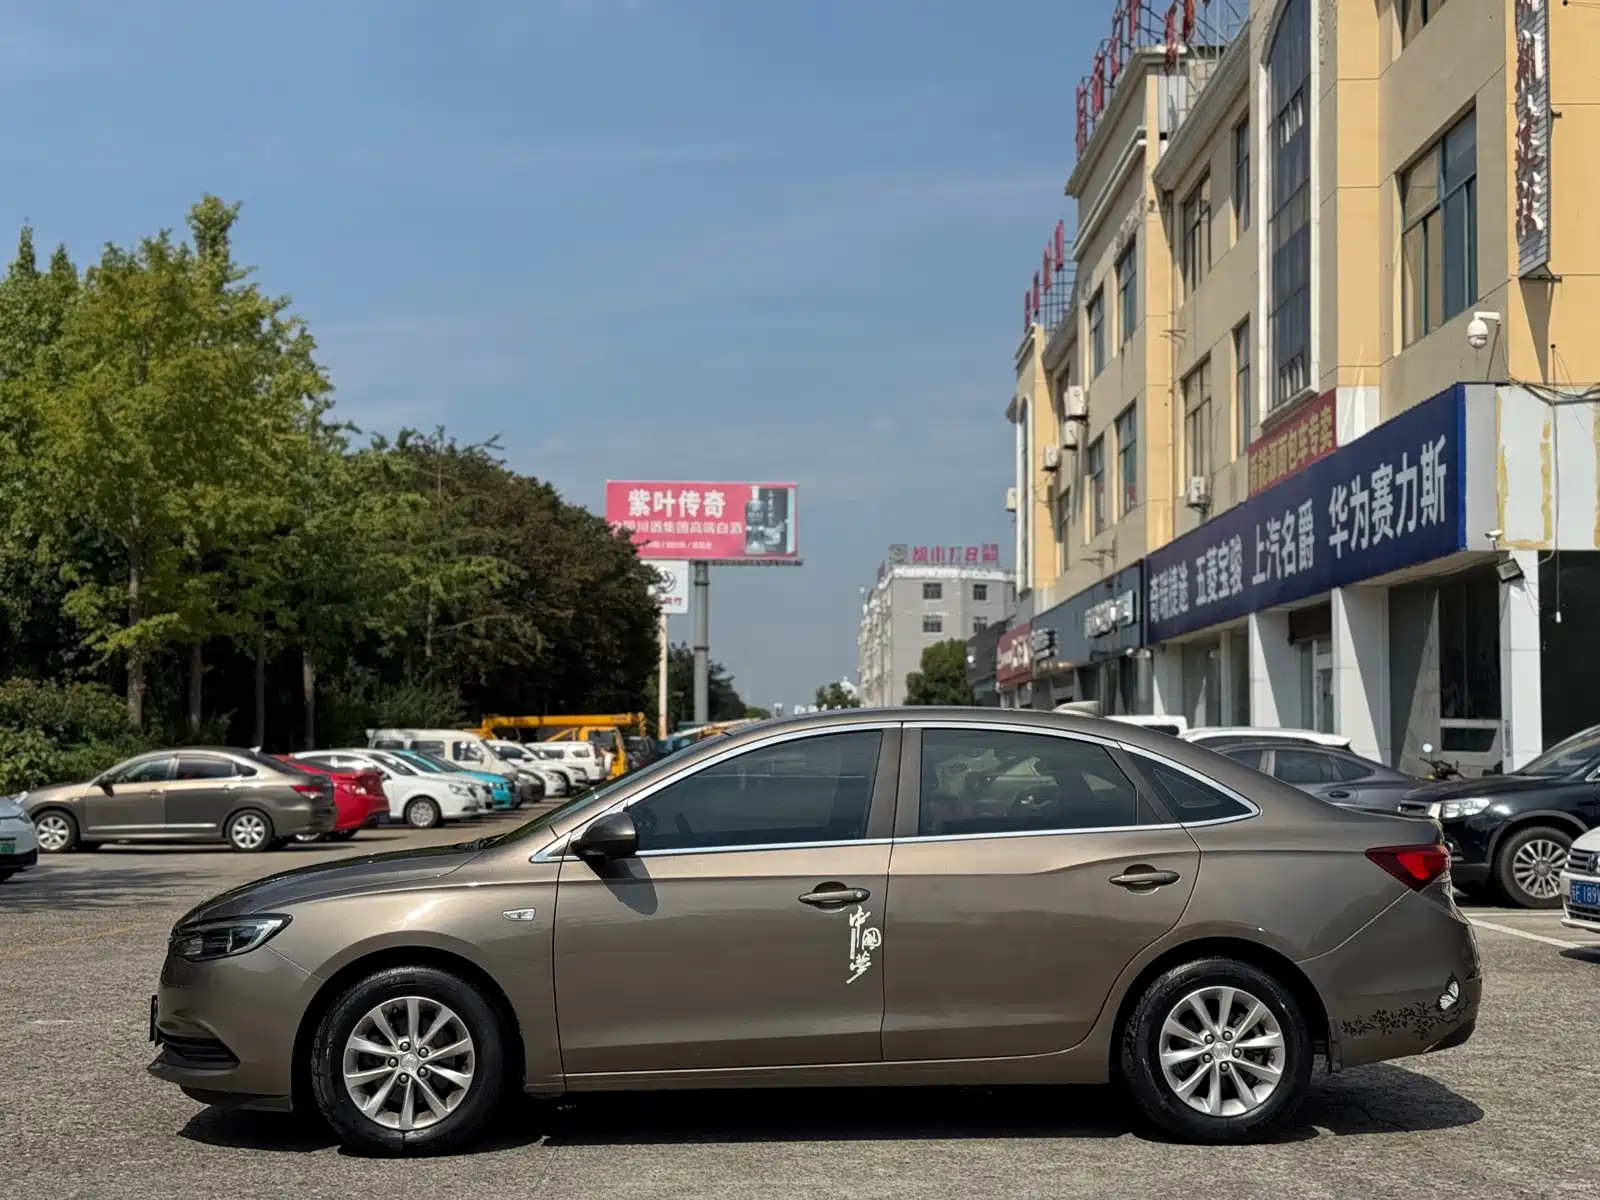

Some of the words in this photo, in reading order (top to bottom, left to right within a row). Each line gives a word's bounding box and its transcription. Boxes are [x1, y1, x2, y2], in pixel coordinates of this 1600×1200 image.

[628, 487, 726, 519] 紫叶传奇
[1195, 533, 1244, 607] 五菱宝骏
[1252, 498, 1316, 586] 上汽名爵
[1328, 433, 1447, 560] 华为赛力斯
